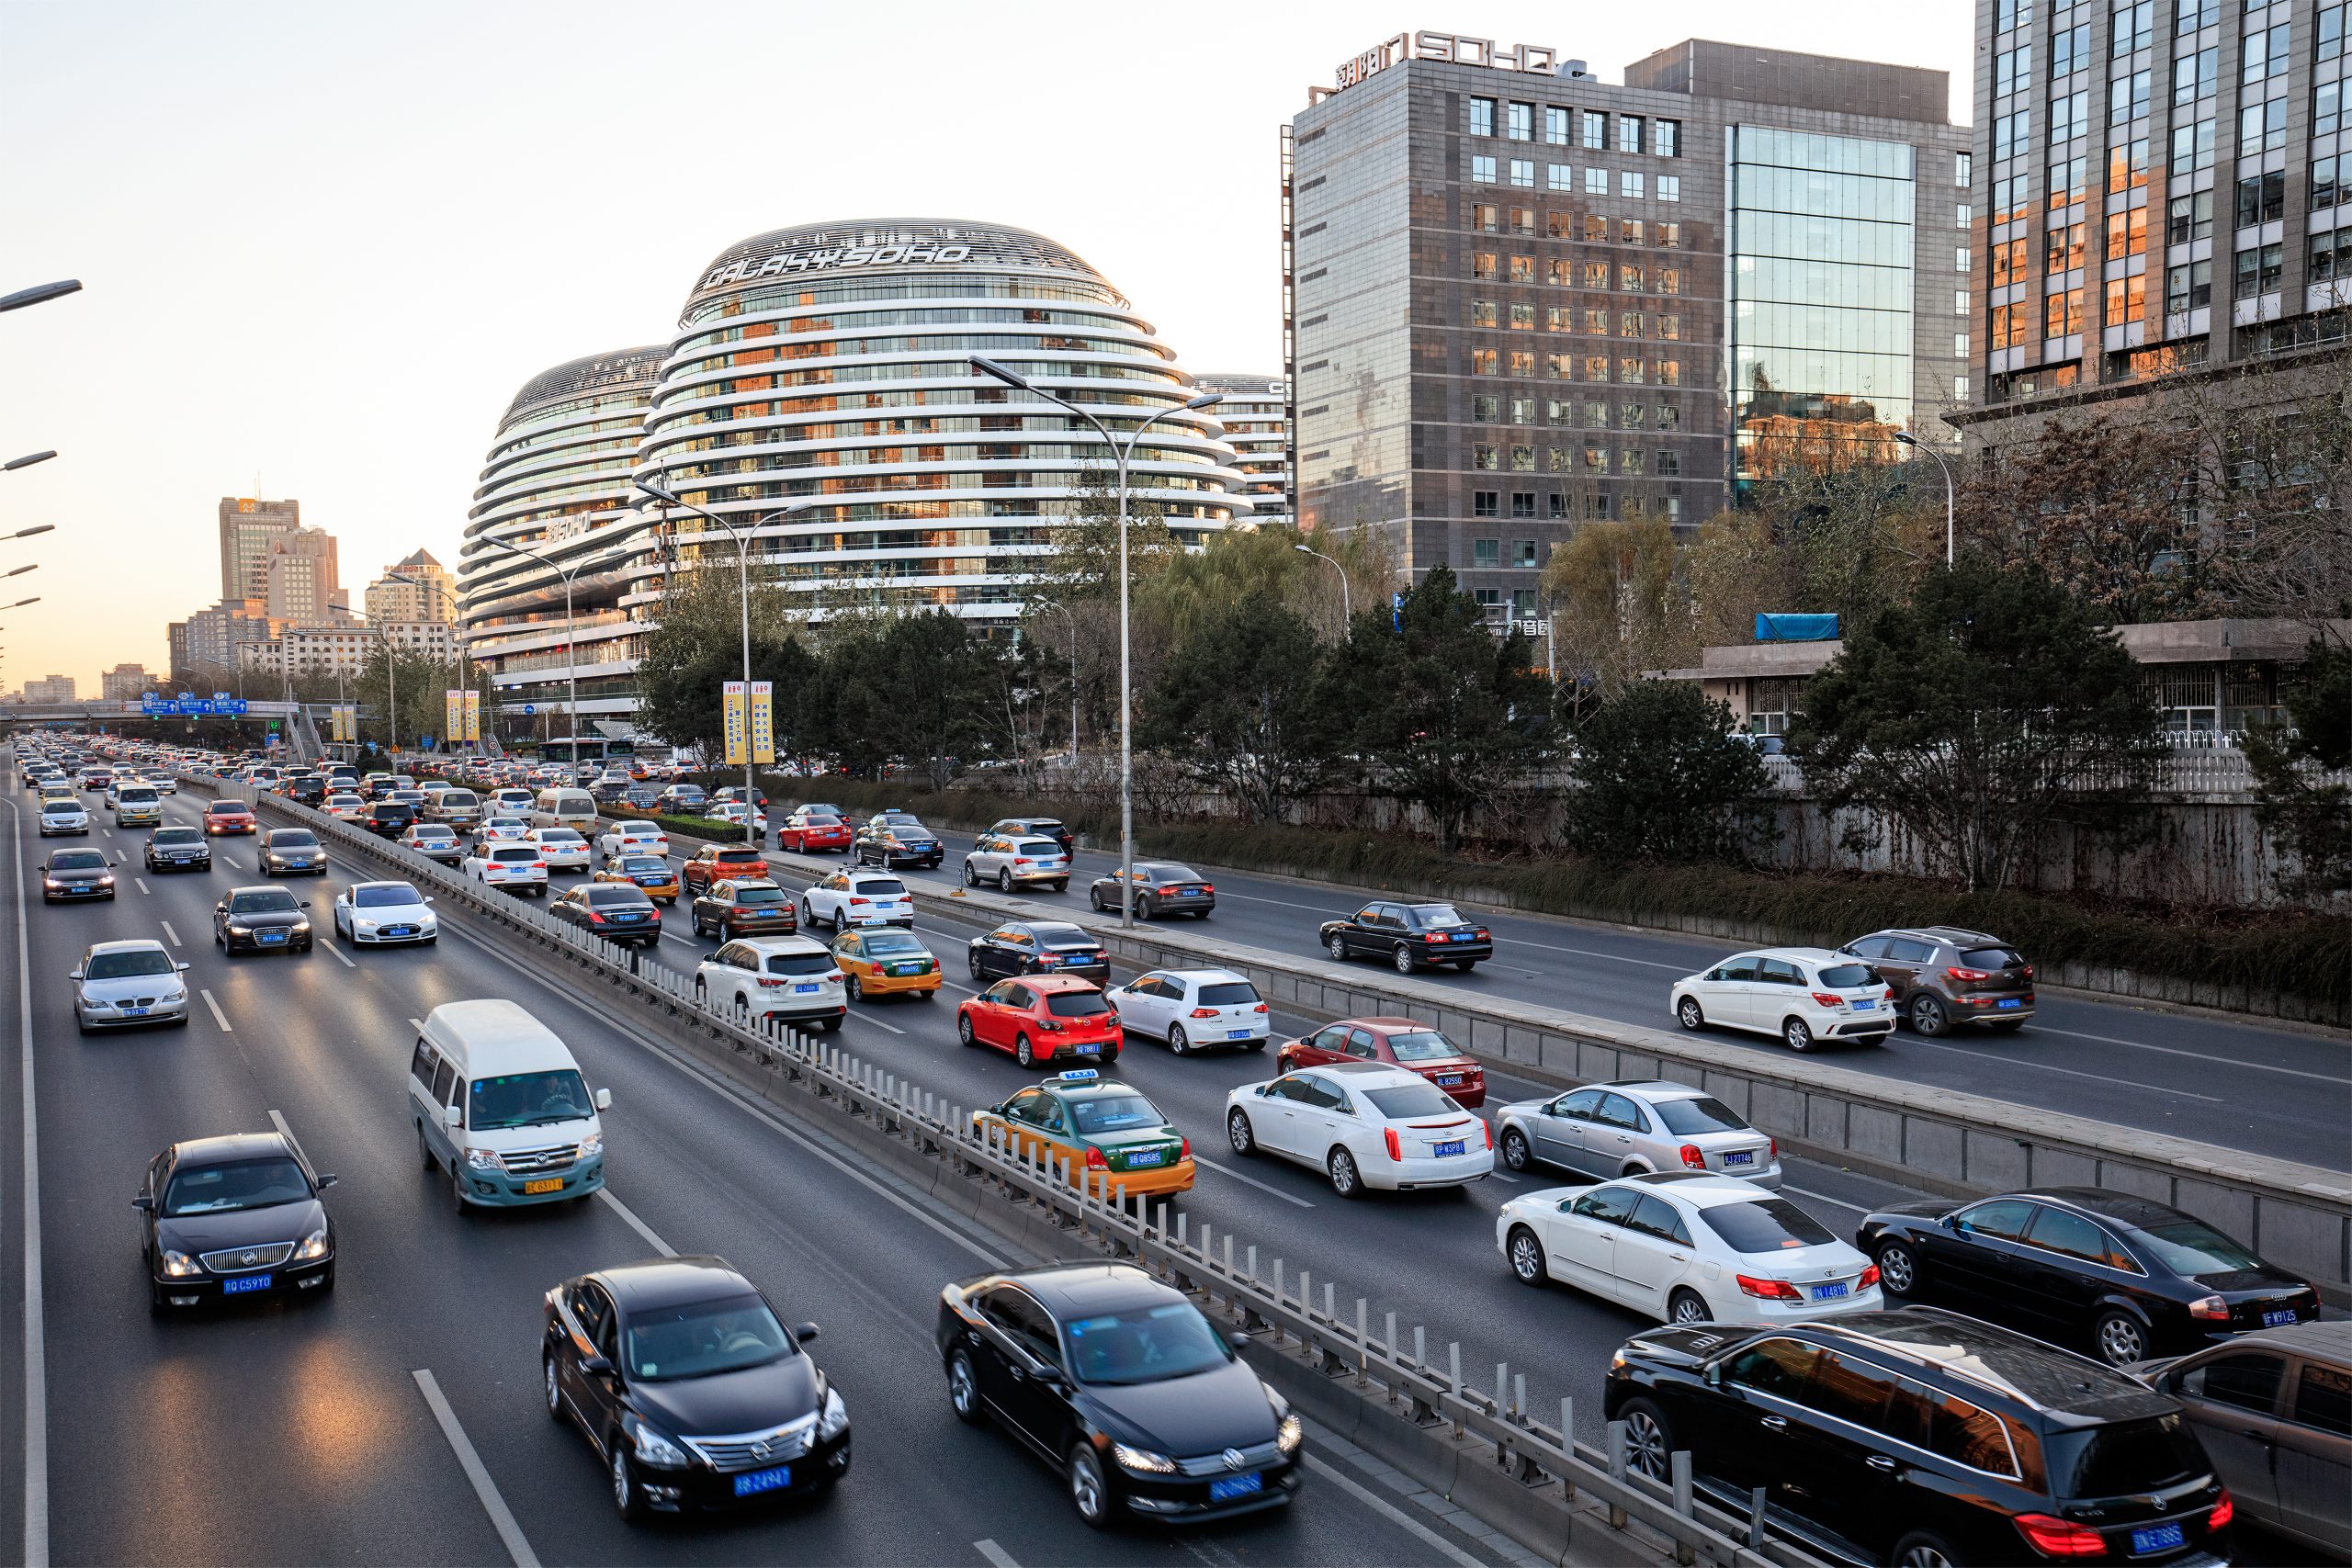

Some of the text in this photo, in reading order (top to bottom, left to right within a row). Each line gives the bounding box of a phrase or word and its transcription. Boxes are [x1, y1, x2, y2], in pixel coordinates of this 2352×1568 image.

[1335, 30, 1556, 91] 朝阳门 SOHO
[840, 246, 971, 267] SOHO
